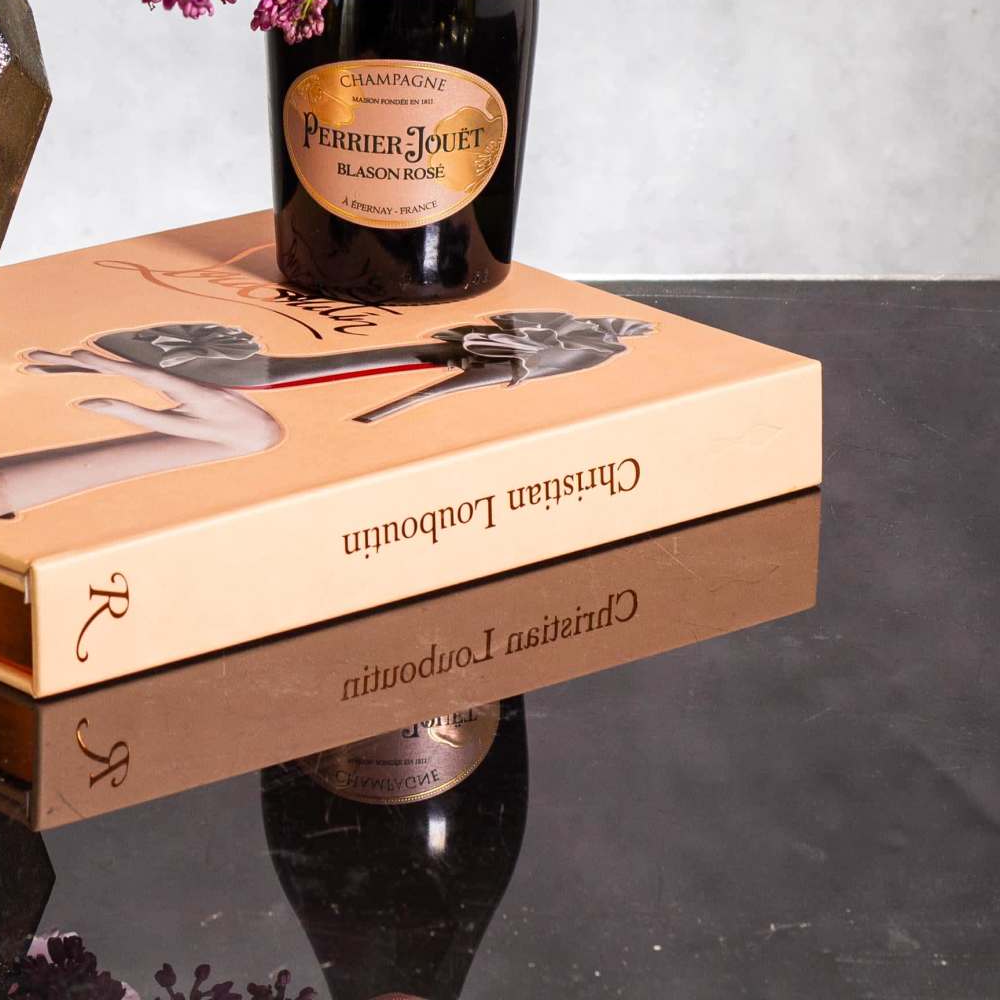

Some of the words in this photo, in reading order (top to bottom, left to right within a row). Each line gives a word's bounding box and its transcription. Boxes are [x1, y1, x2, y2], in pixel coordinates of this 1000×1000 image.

[339, 73, 447, 92] CHAMPAGNE
[303, 112, 485, 164] PERRIER-JOUËT
[337, 162, 400, 180] BLASON
[403, 163, 446, 180] ROSÉ
[351, 200, 393, 216] ÉPERNAY
[400, 201, 438, 215] FRANCE
[508, 457, 641, 512] Christian
[342, 494, 497, 559] Louboutin
[76, 572, 130, 663] R
